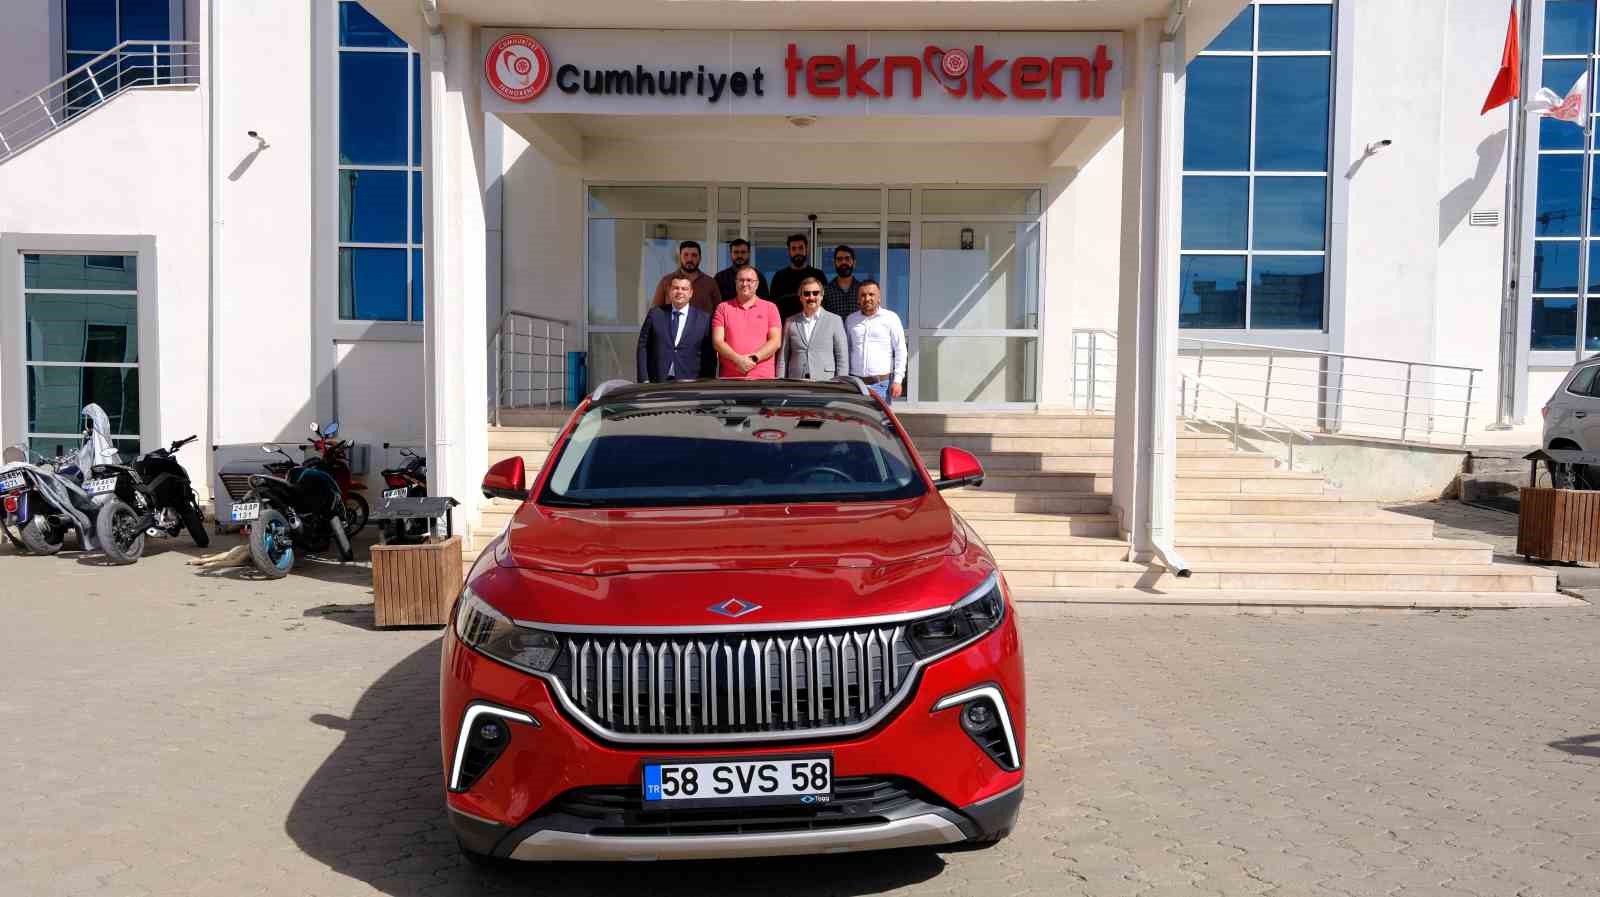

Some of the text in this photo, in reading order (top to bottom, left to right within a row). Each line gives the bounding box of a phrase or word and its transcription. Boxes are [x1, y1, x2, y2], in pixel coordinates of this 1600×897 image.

[556, 43, 1113, 103] Cumhuriyet teknokent
[648, 762, 828, 796] TR 58 SVS 58
